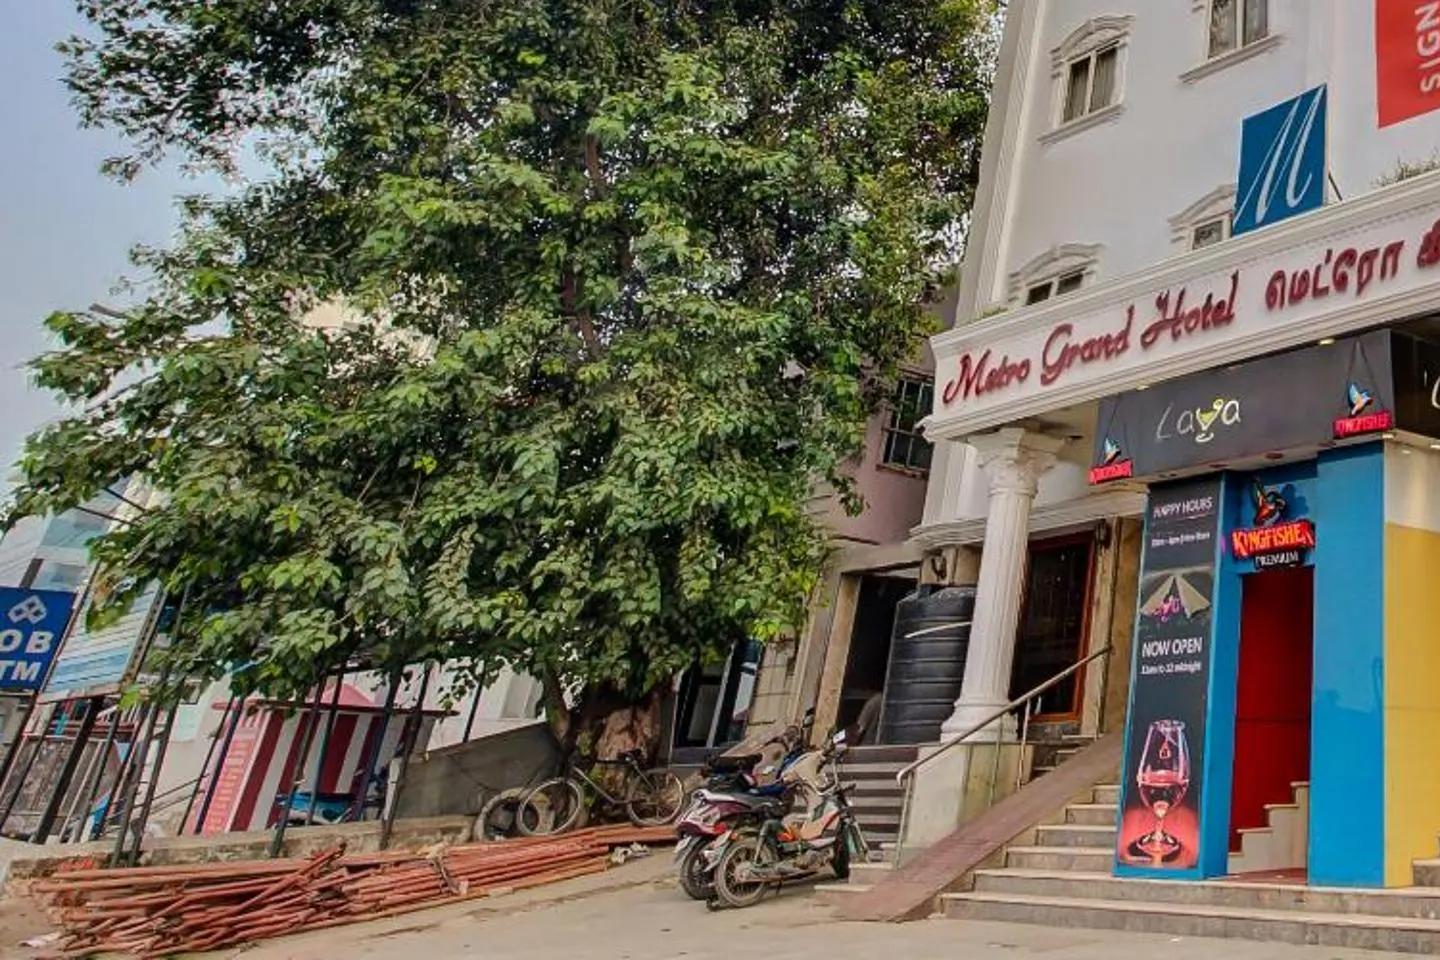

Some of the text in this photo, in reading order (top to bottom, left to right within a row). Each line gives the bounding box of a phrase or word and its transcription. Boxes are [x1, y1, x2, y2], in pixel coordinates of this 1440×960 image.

[942, 269, 1240, 404] Metro Grand Hotel
[1141, 636, 1203, 659] NOW OPEN
